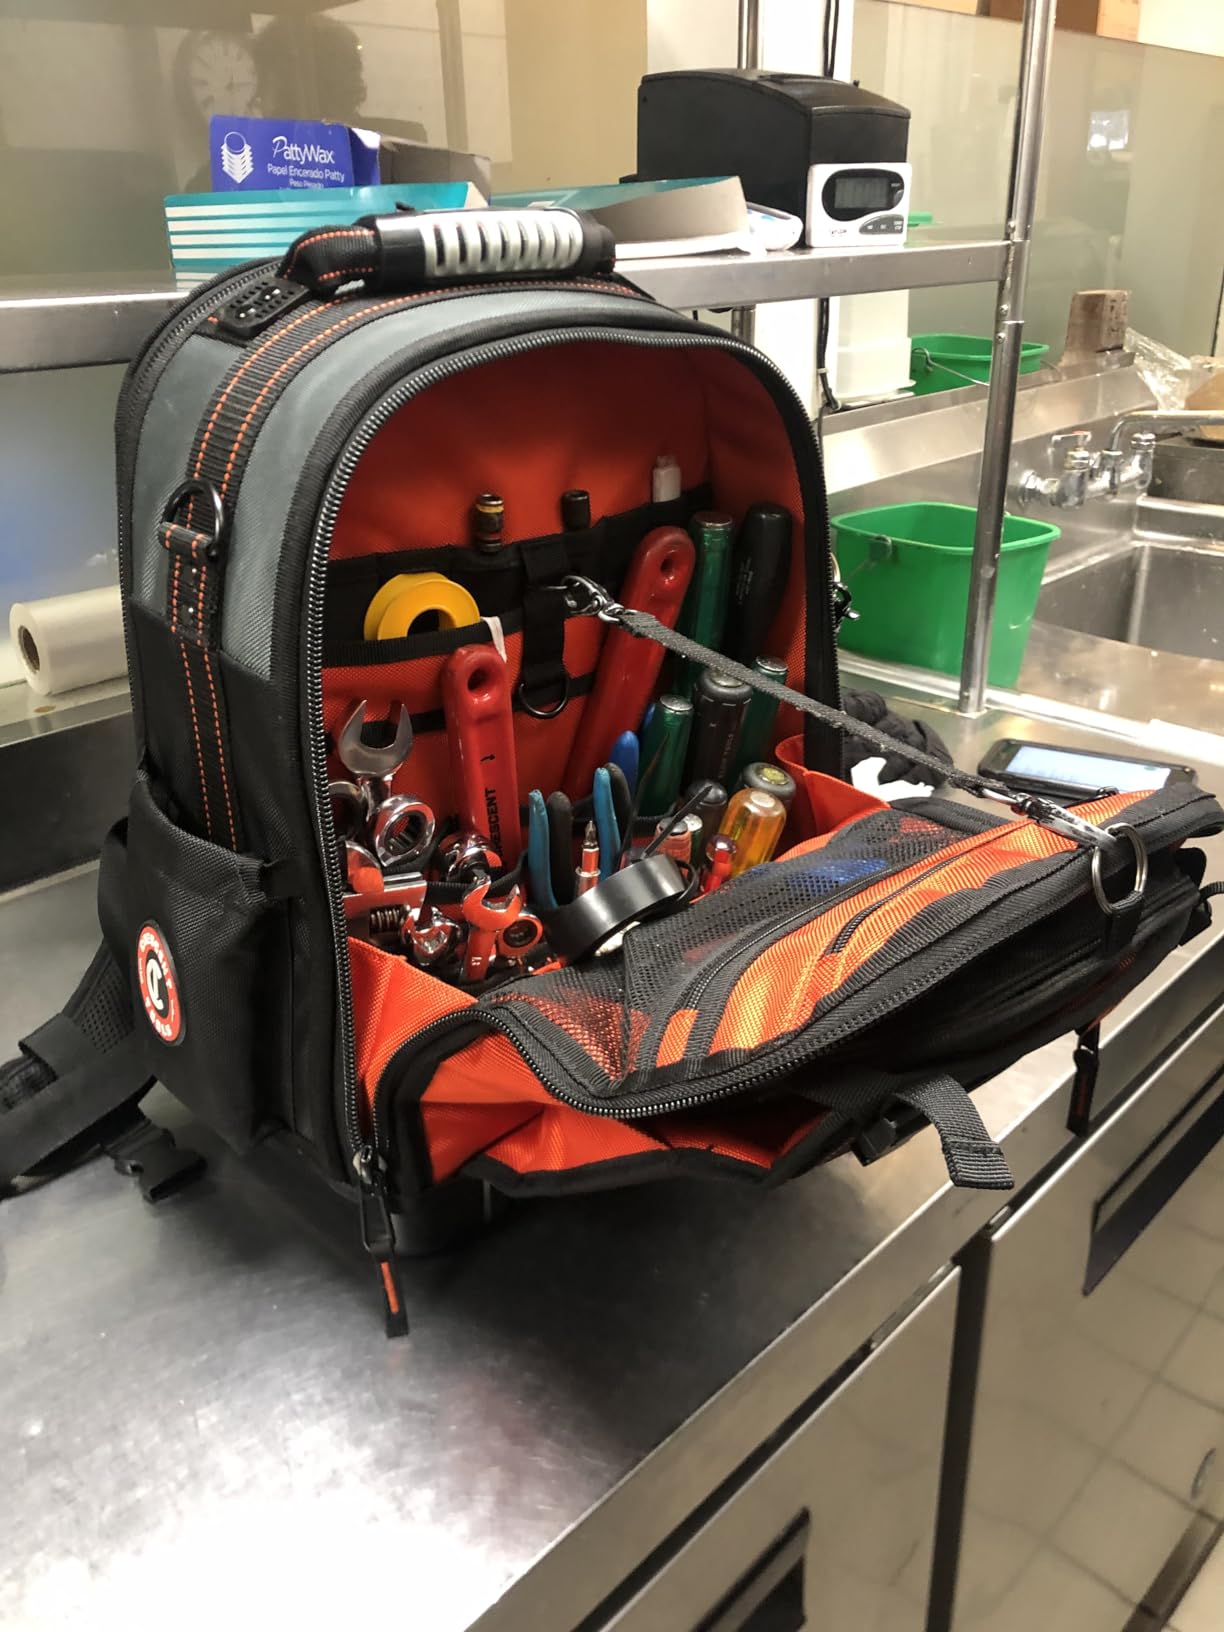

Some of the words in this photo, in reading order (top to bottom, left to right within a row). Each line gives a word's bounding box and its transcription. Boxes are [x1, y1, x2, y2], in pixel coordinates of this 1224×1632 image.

[272, 136, 335, 164] PattyWax
[267, 163, 287, 176] Papel
[288, 166, 323, 179] Encerado
[324, 168, 344, 183] Patty
